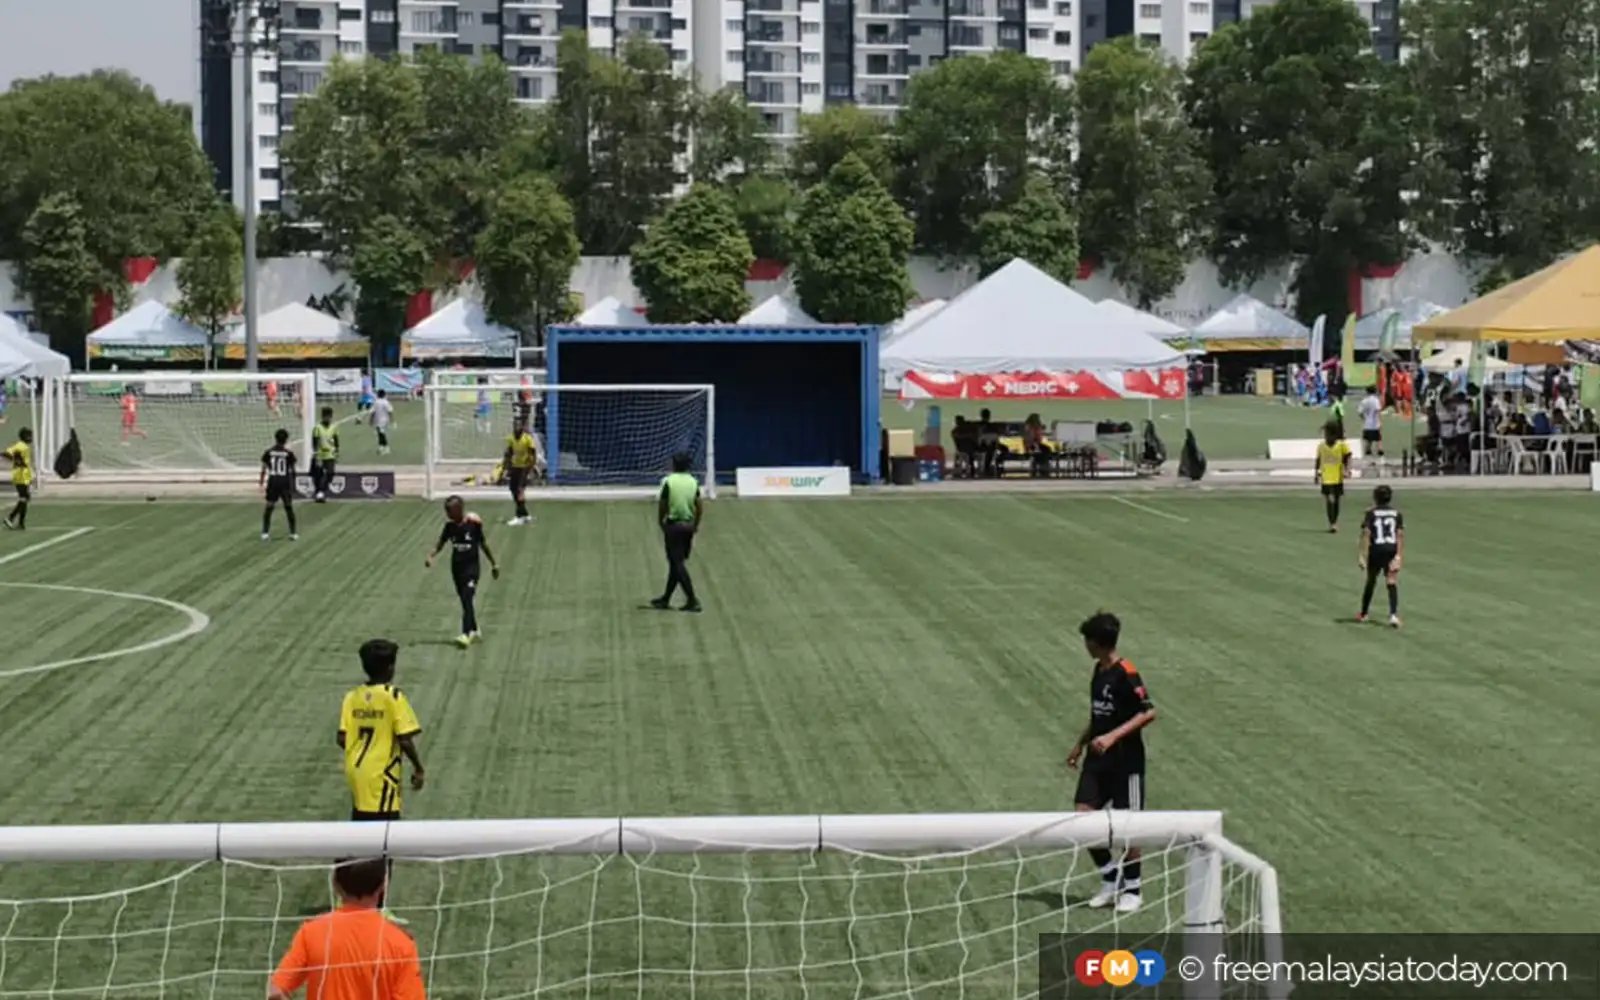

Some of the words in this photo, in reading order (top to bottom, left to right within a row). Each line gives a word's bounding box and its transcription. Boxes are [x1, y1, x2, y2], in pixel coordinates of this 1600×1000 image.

[1004, 380, 1057, 395] MEDIC
[269, 456, 287, 476] 10
[1374, 517, 1397, 544] 13
[354, 726, 375, 768] 7
